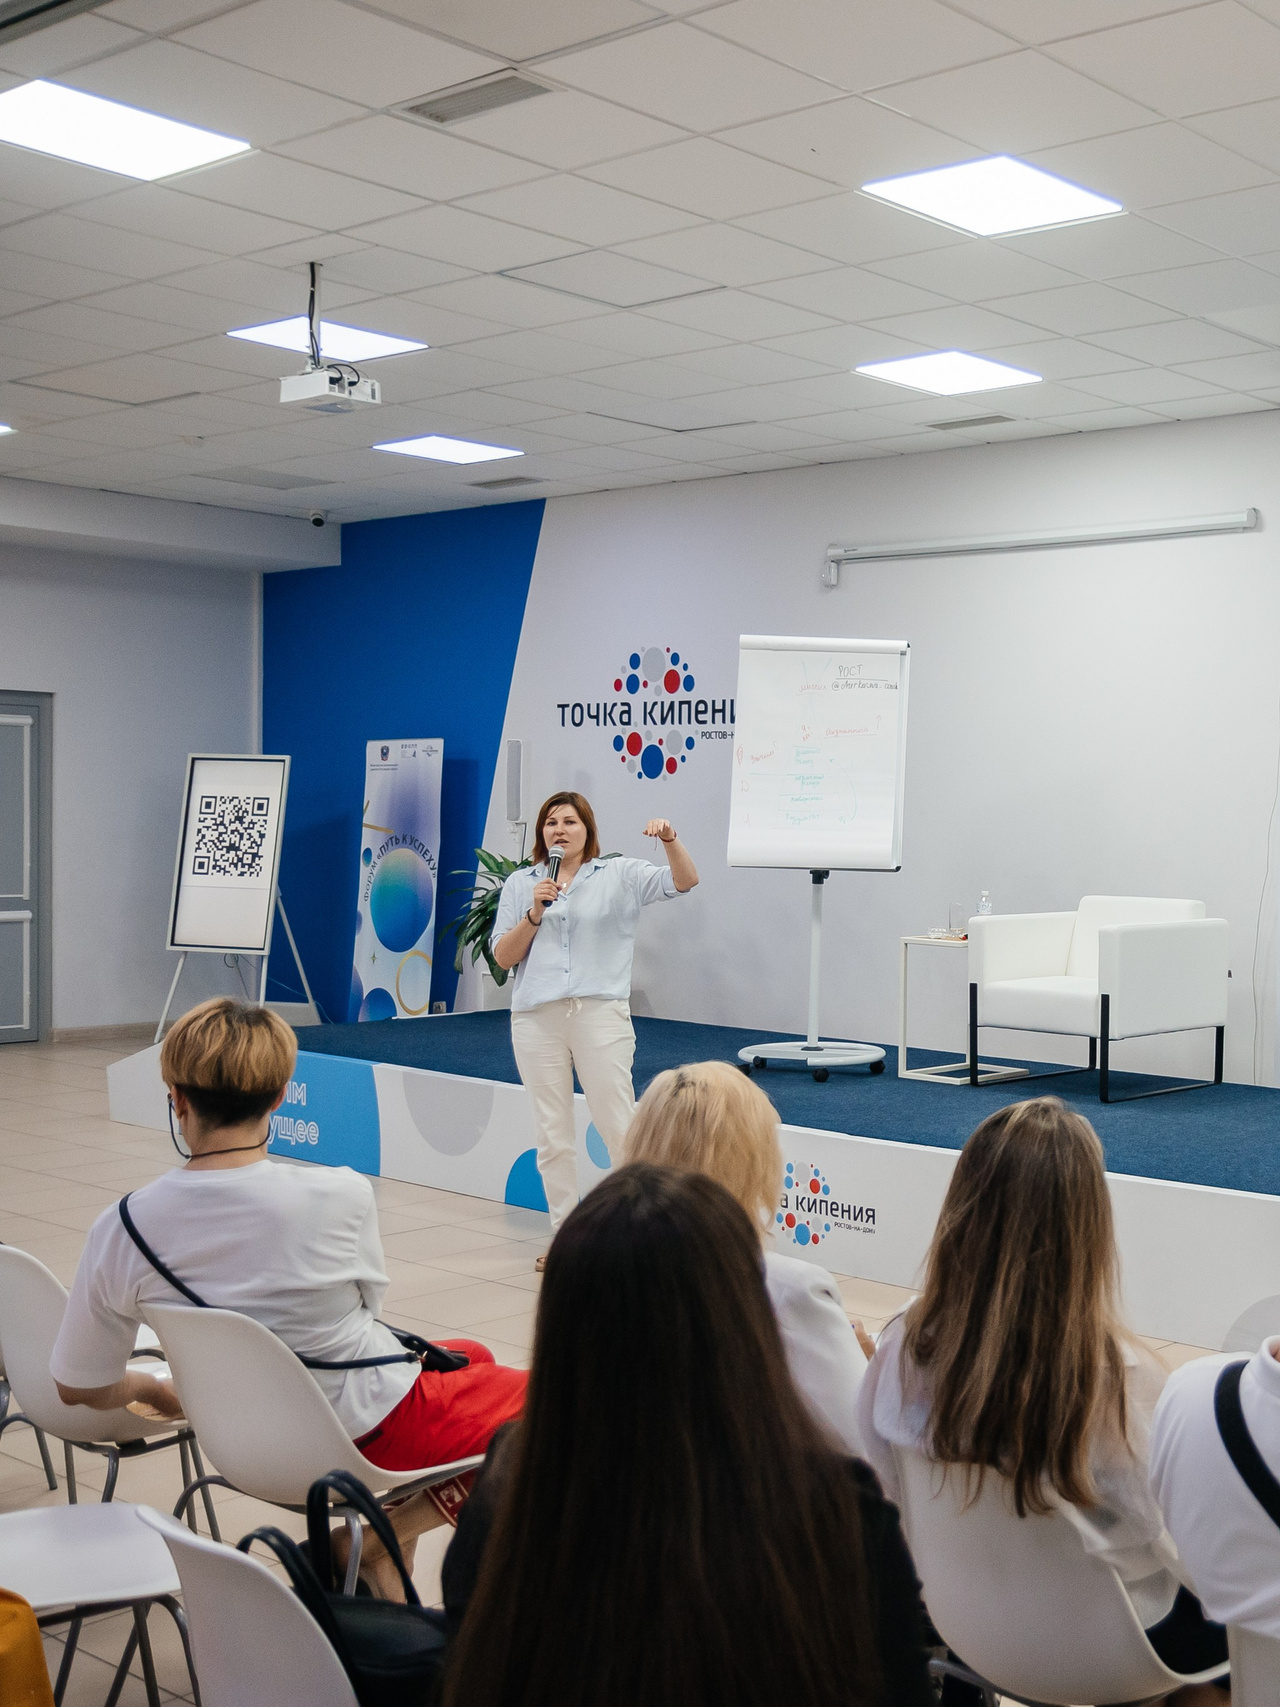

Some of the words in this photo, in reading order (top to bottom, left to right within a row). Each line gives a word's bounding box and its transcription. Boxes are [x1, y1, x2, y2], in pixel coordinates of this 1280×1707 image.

[557, 702, 632, 727] точка
[377, 836, 401, 861] «ПУТЬ
[402, 834, 407, 844] К
[409, 835, 437, 879] УСПЕХУ»
[268, 1115, 319, 1146] ущее
[796, 1195, 876, 1225] кипения
